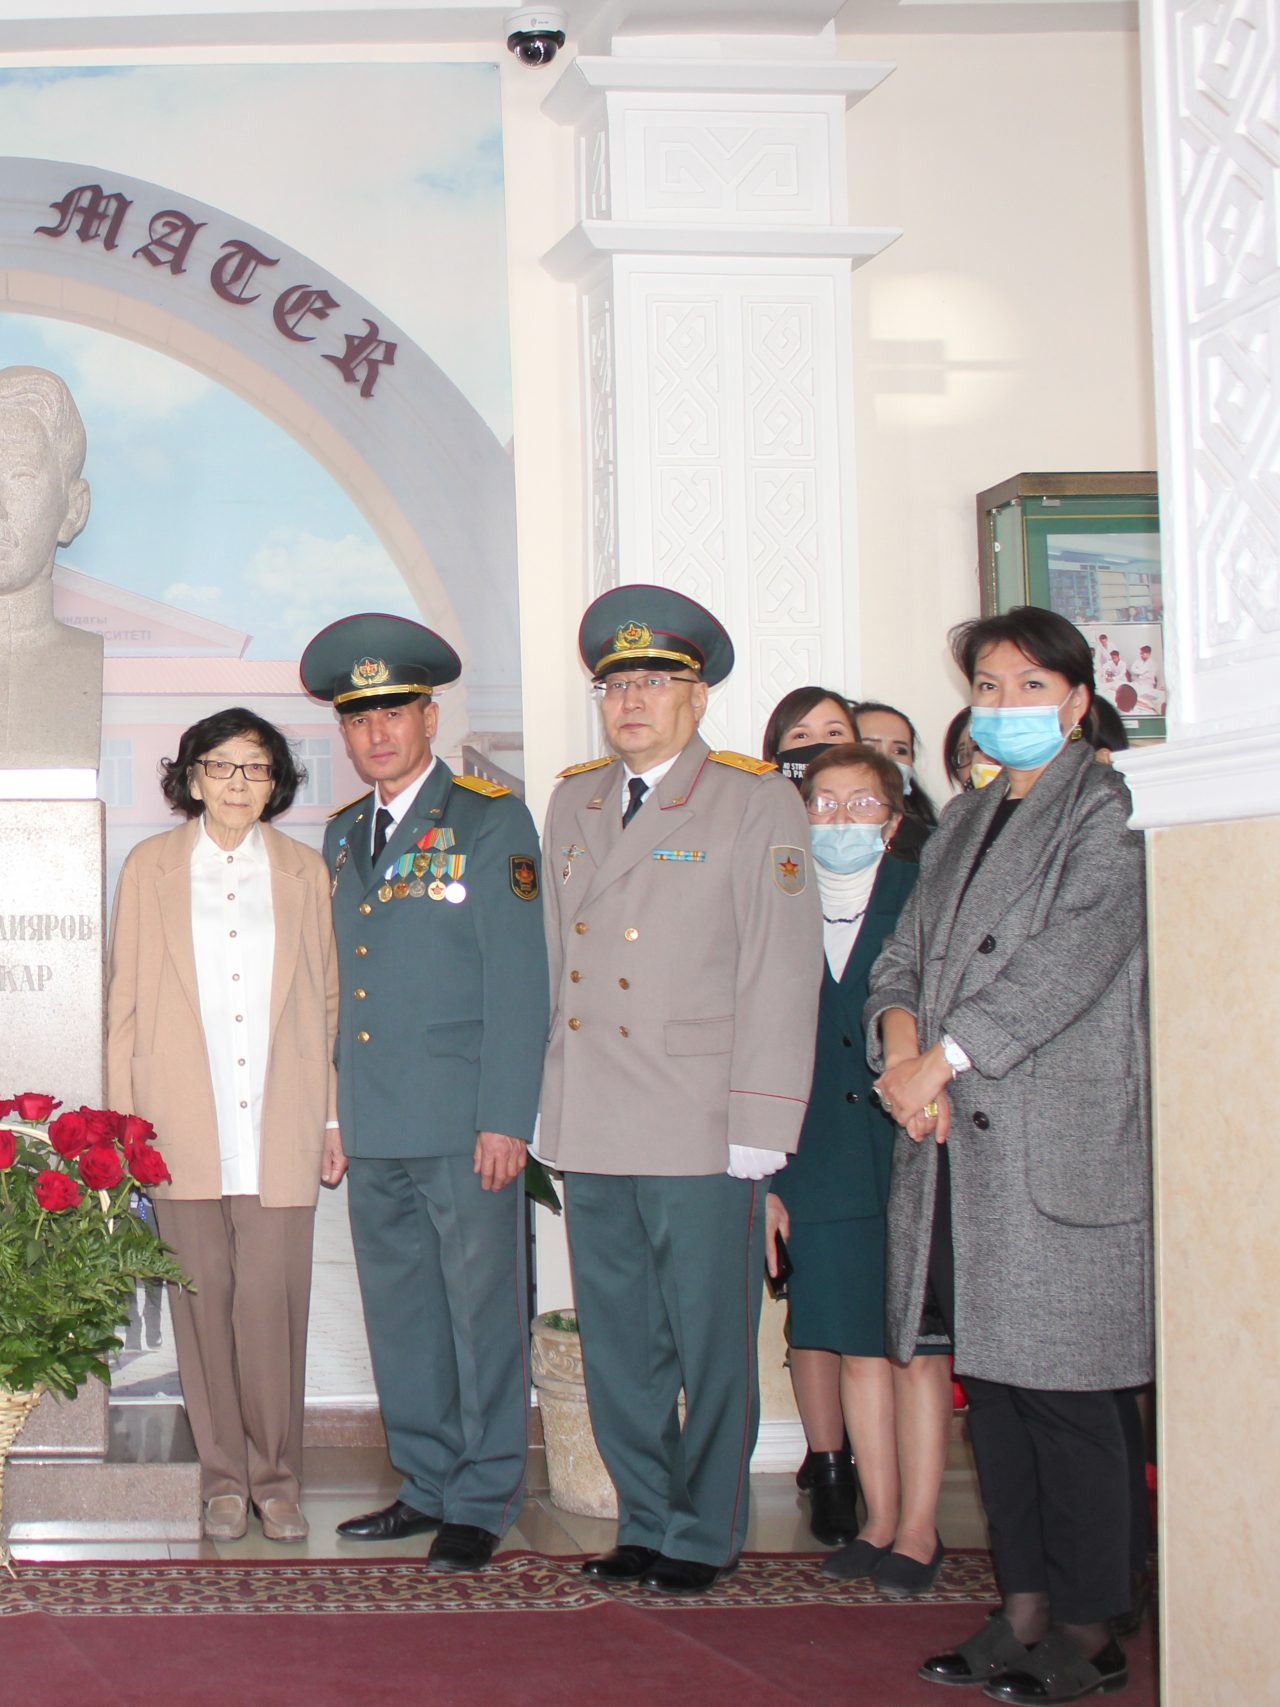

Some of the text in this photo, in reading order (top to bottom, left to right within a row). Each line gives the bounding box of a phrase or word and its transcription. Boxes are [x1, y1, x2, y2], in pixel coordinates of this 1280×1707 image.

[34, 184, 397, 399] MATER
[791, 762, 810, 771] STRE
[793, 770, 804, 779] PA
